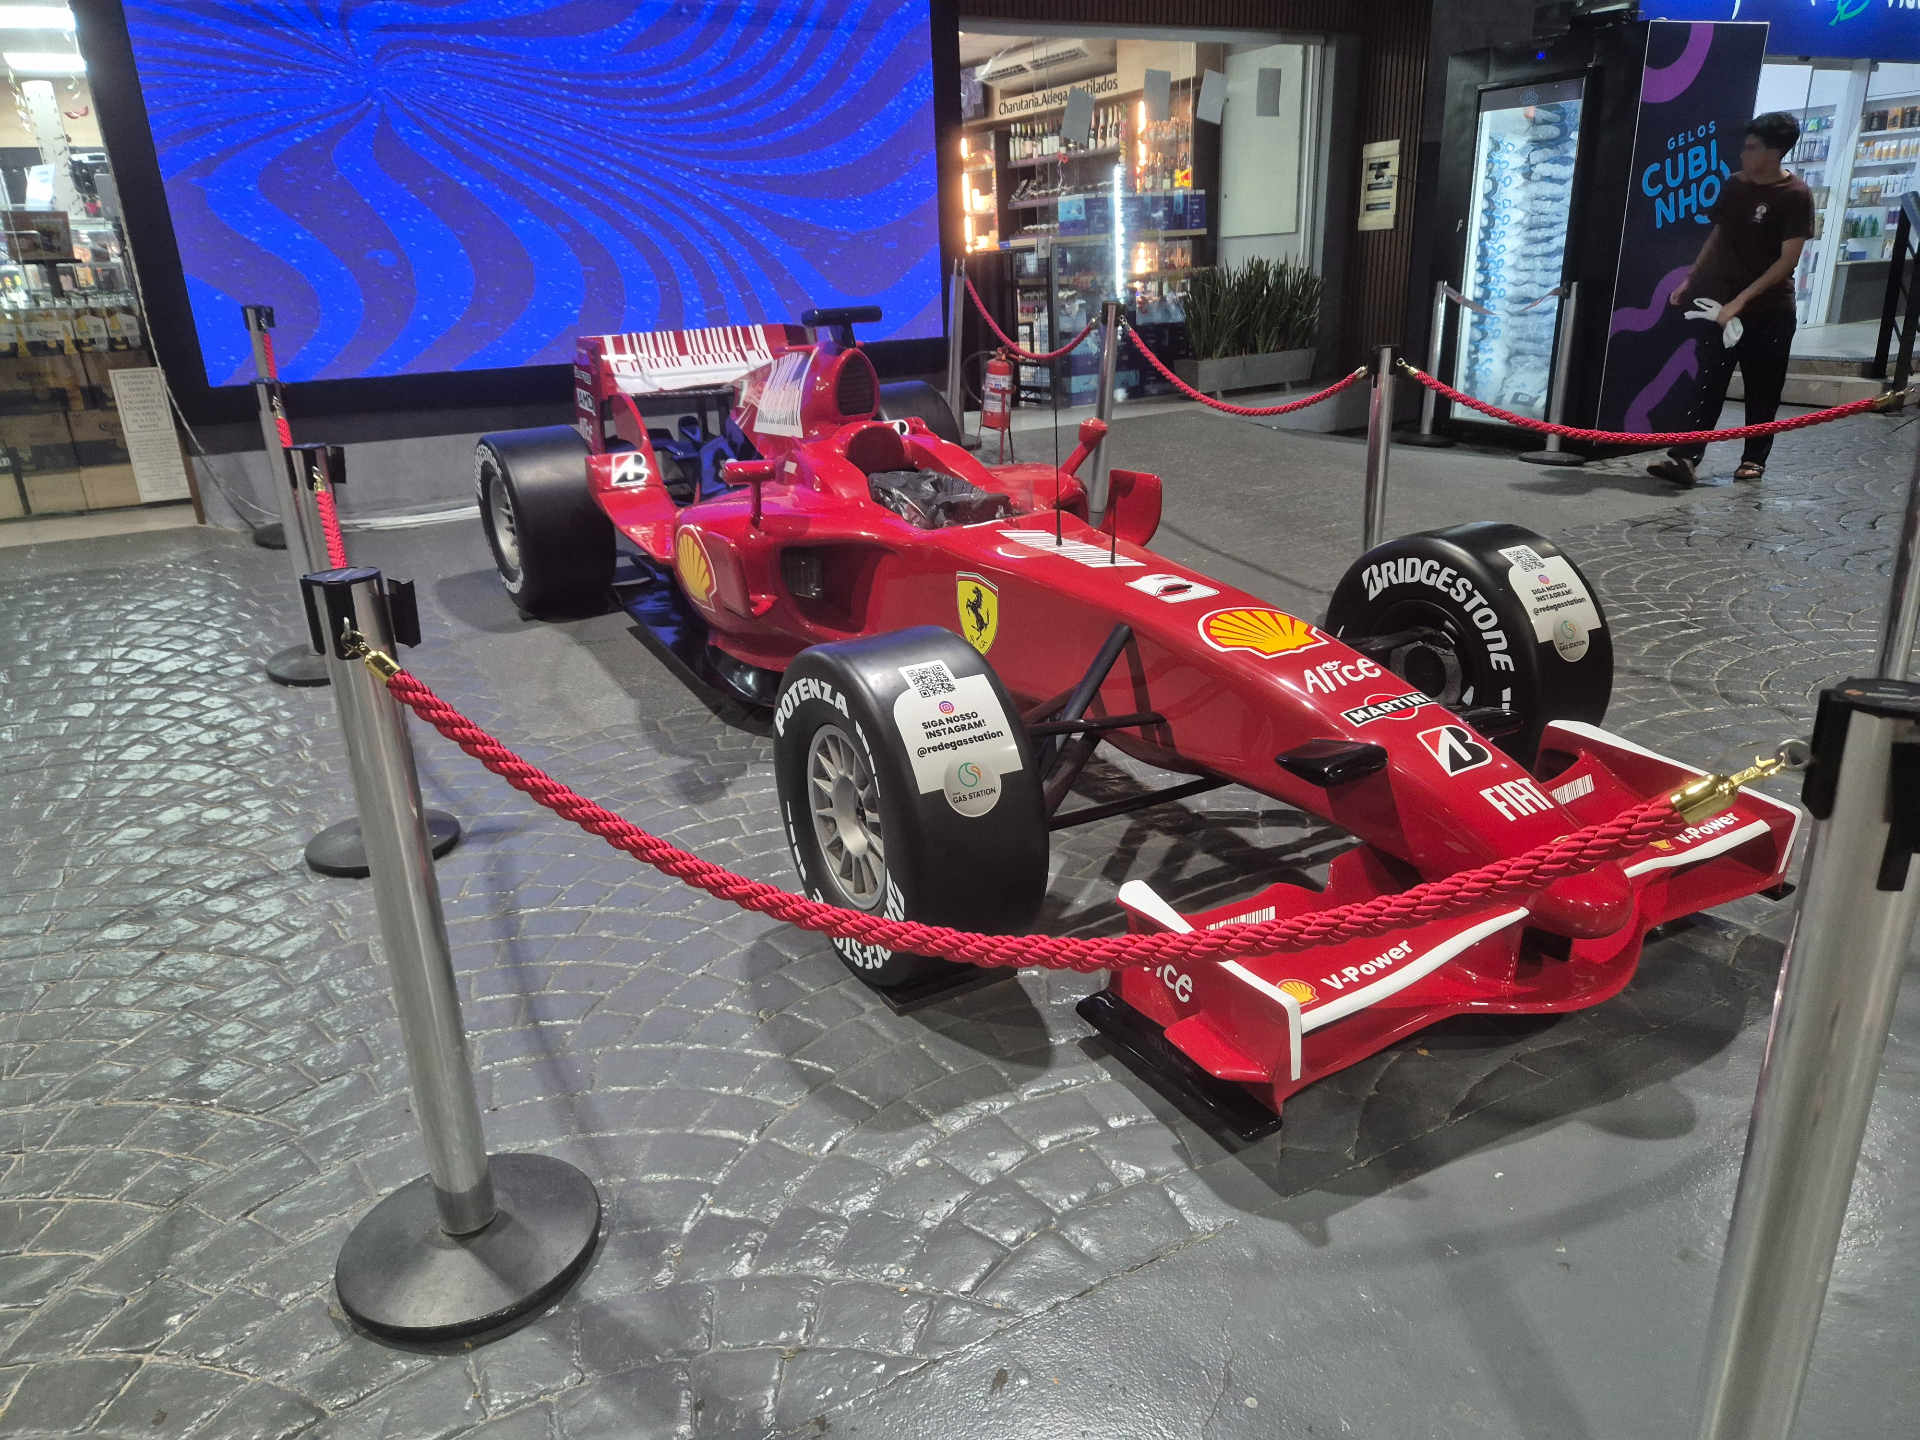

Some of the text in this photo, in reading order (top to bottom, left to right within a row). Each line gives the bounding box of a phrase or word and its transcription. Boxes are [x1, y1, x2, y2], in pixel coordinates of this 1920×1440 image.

[1078, 76, 1118, 96] stilados
[1667, 120, 1716, 150] GELOS
[1641, 139, 1718, 197] CUBI
[1654, 175, 1721, 229] NHO
[1535, 588, 1574, 602] INSTAGRAM!
[1361, 557, 1515, 672] BRIDGESTONE
[1303, 657, 1382, 694] Alice
[775, 677, 850, 738] POTENZA
[921, 711, 979, 730] SIGA NOSSO
[1350, 693, 1430, 722] MARTINI
[916, 729, 1004, 758] @redegasstation
[925, 718, 987, 740] INSTAGRAM!
[952, 786, 997, 804] GAS STATION
[1478, 777, 1555, 822] FIAT
[1674, 812, 1740, 844] V-Power
[1320, 939, 1414, 991] V-Power
